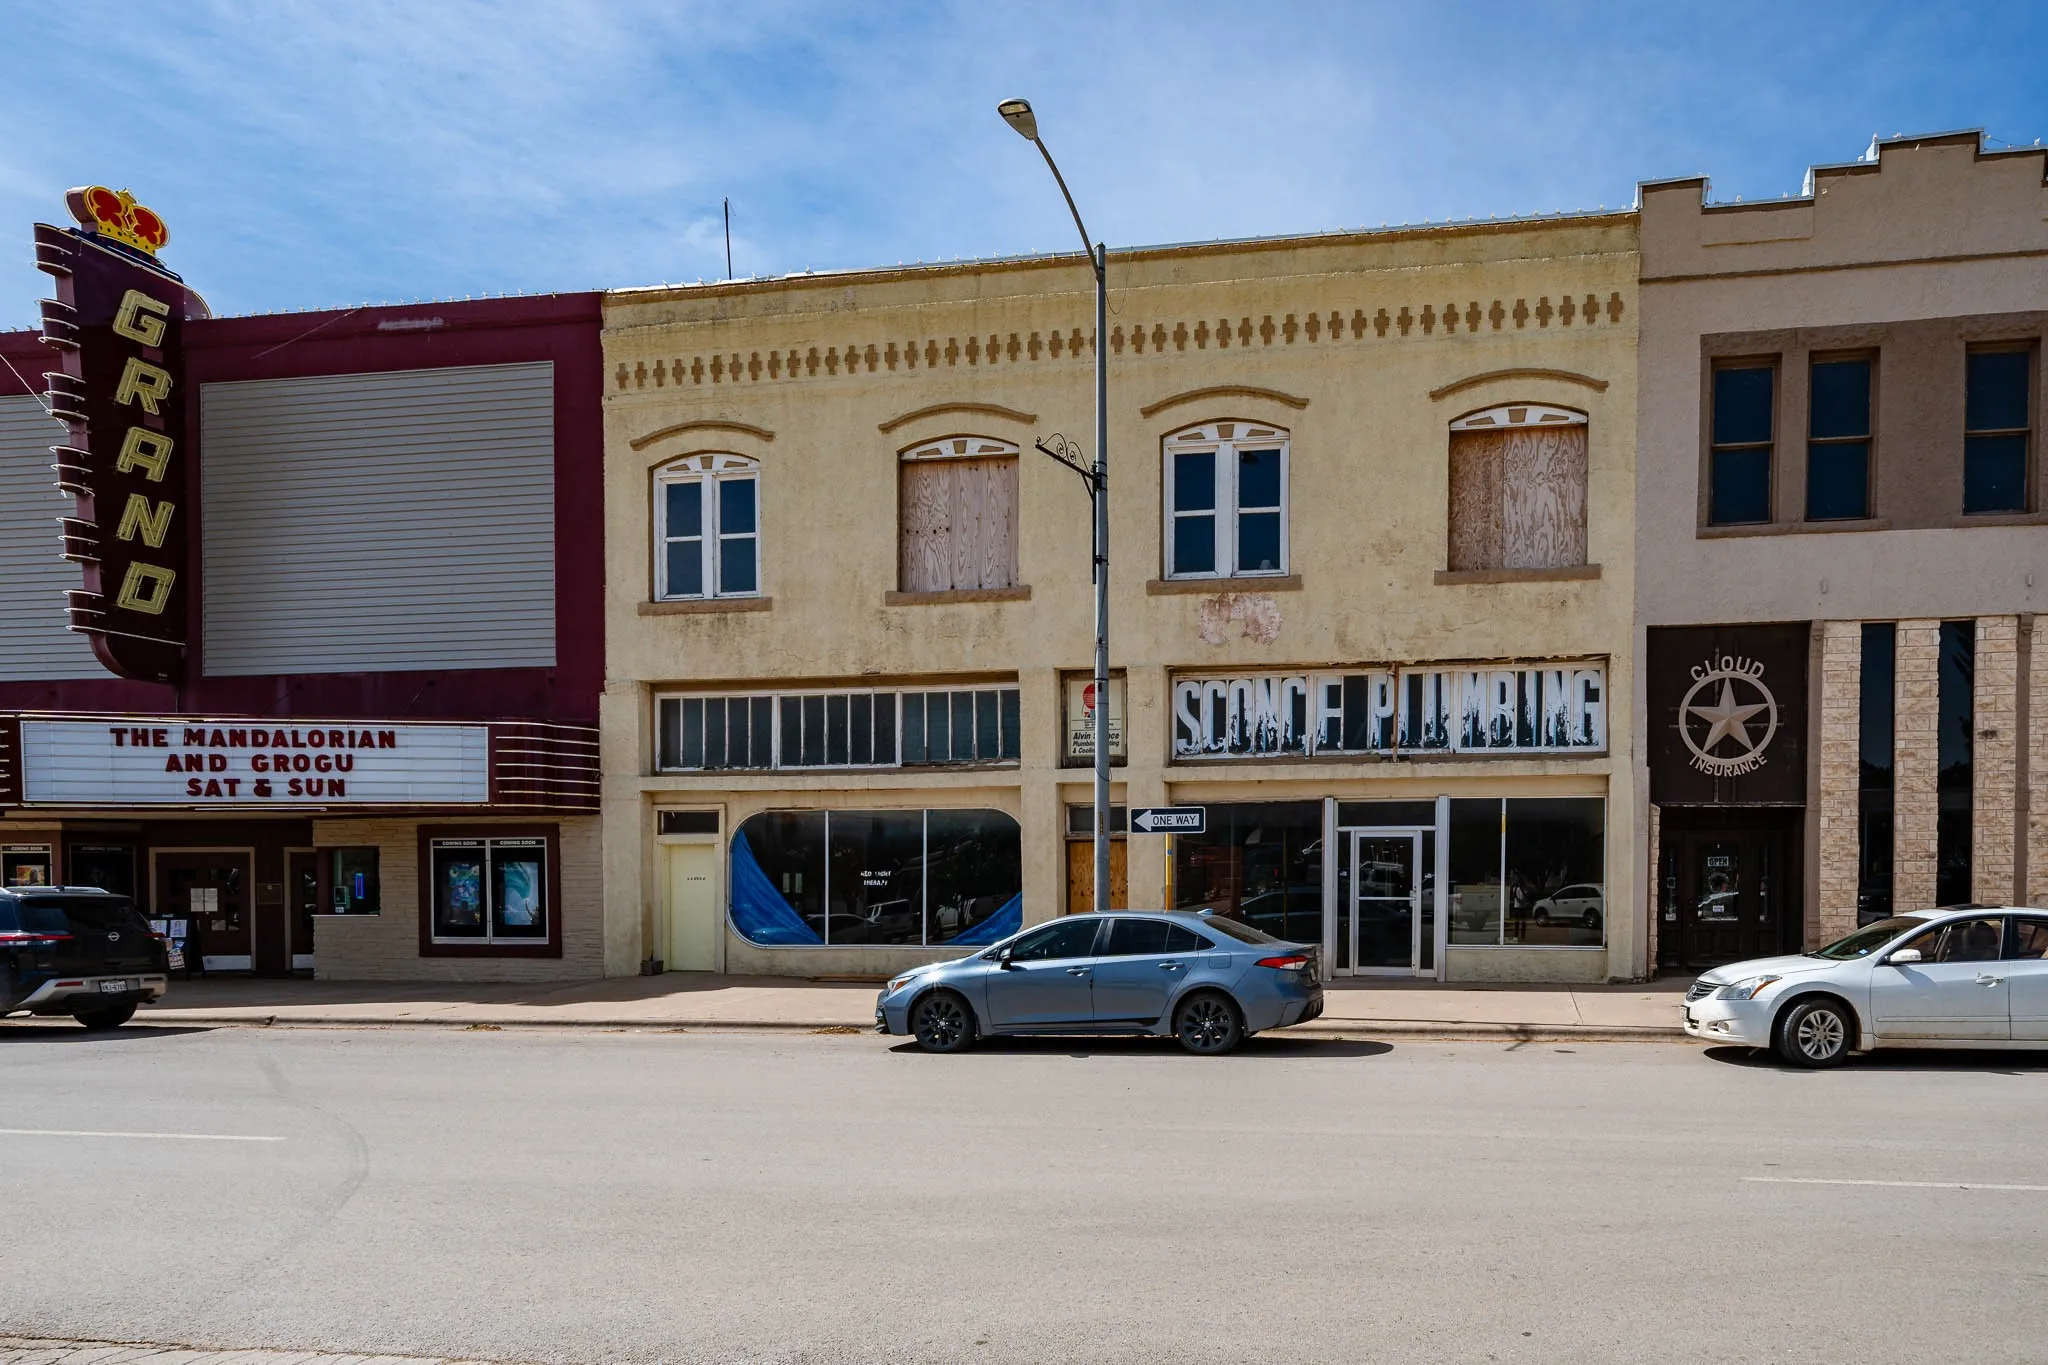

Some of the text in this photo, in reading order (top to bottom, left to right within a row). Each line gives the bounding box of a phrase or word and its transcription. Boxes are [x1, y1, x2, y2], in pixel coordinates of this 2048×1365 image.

[112, 288, 176, 616] GRAND
[1690, 655, 1765, 682] CLOUD
[110, 728, 396, 749] THE MANDALORIAN
[1073, 732, 1091, 740] Alvin
[165, 753, 354, 773] AND GROGU
[1689, 752, 1767, 777] INSURANCE
[186, 778, 346, 798] SAT & SUN
[1153, 815, 1197, 825] ONE WAY
